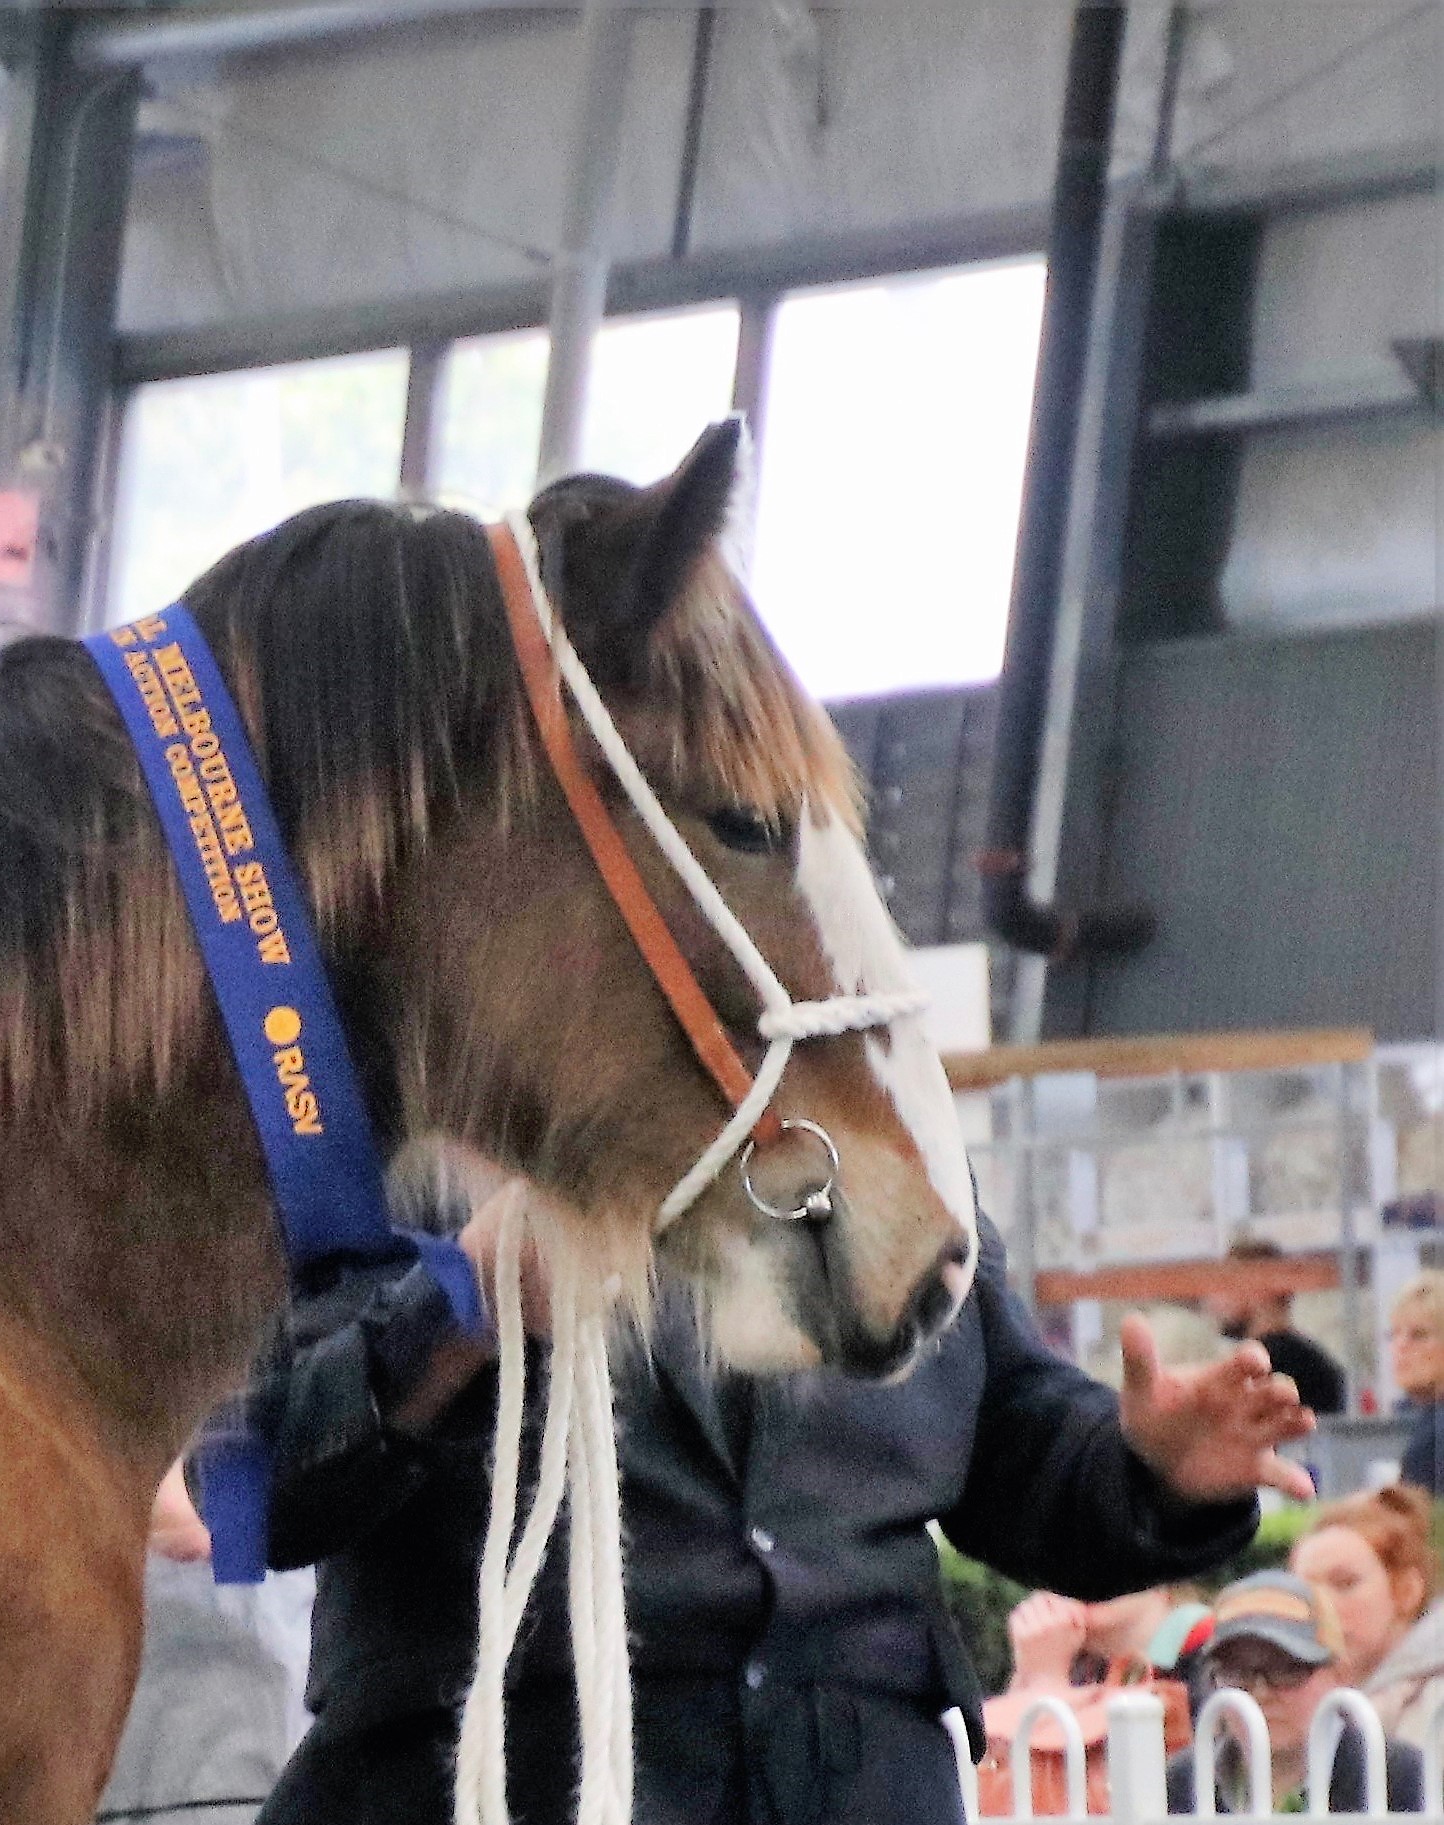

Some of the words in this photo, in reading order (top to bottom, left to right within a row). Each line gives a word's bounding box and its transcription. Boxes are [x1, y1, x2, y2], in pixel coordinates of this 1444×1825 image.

[123, 651, 180, 738] ACTION
[166, 743, 242, 923] COMPETITION
[151, 642, 254, 856] MELBOURNE
[234, 862, 292, 964] SHOW
[273, 1045, 324, 1134] RASV
